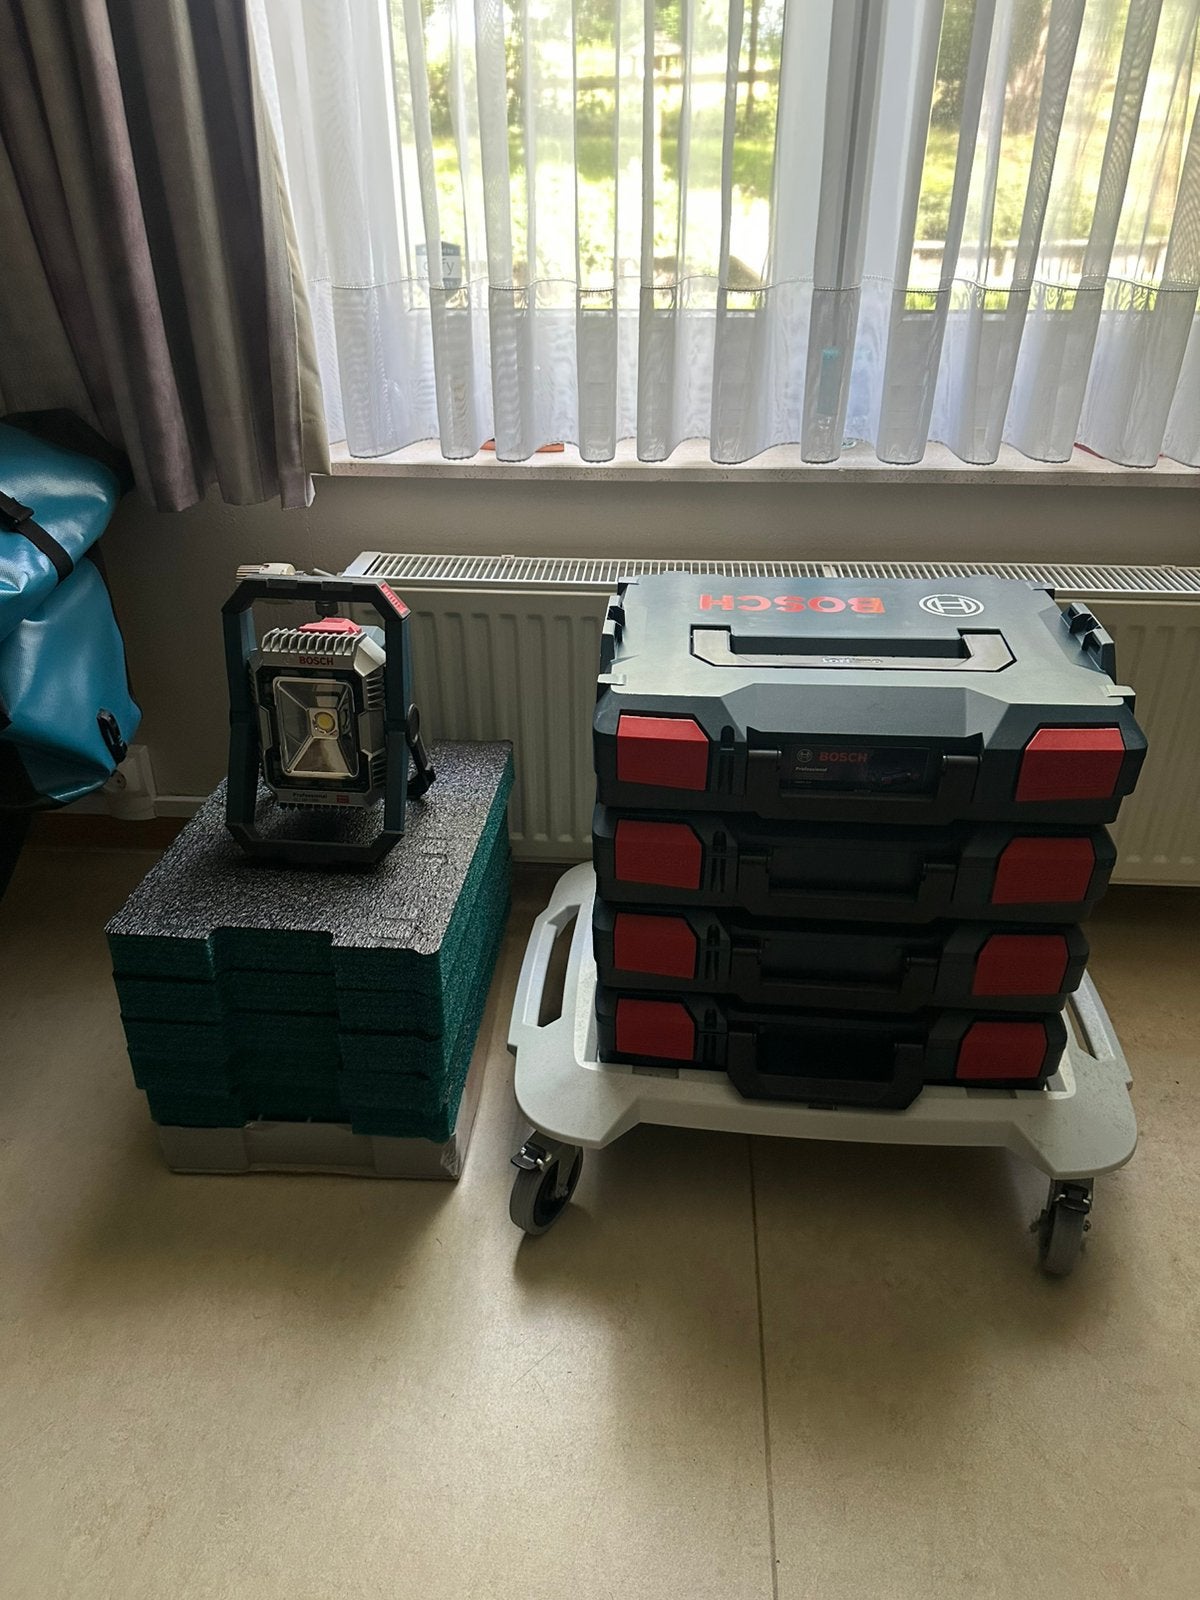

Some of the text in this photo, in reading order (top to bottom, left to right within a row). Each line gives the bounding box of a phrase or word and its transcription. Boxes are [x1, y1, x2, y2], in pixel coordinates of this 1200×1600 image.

[699, 594, 886, 613] BOSCH
[299, 656, 334, 666] BOSCH
[818, 751, 868, 763] BOSCH
